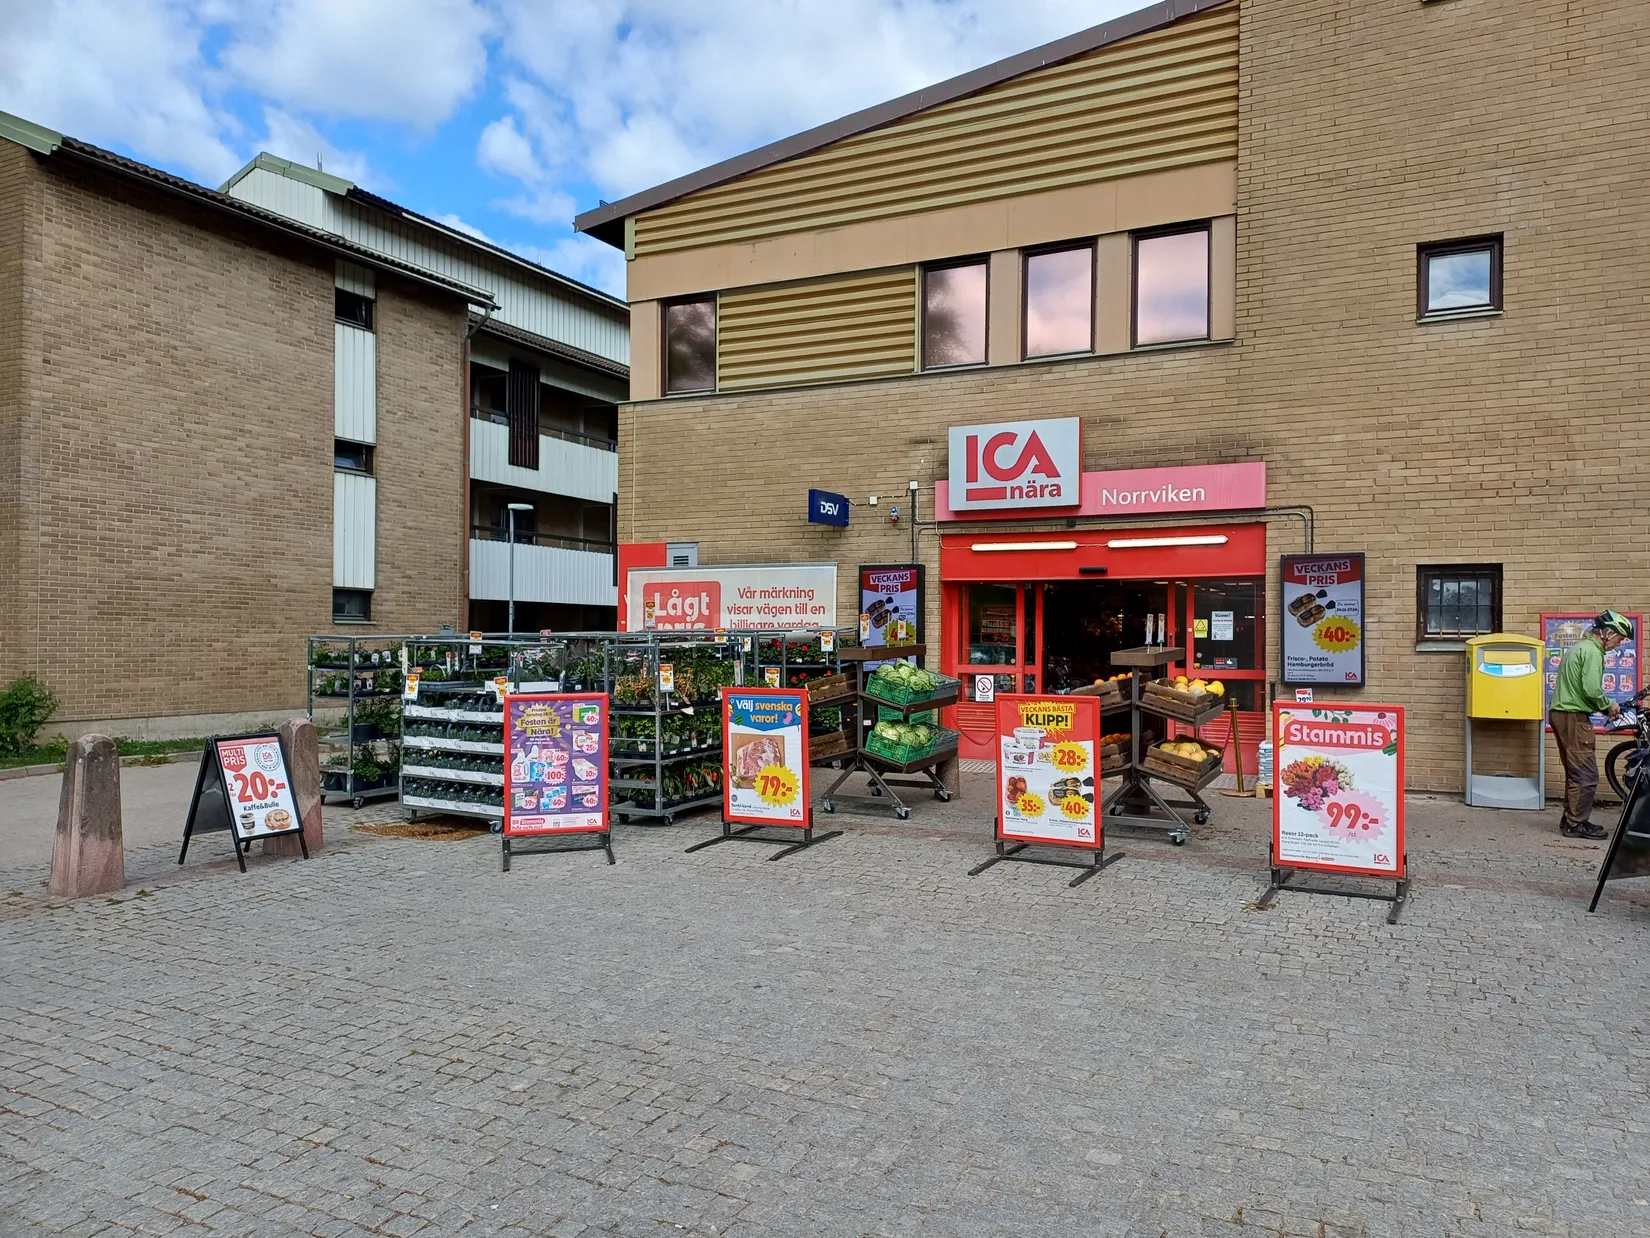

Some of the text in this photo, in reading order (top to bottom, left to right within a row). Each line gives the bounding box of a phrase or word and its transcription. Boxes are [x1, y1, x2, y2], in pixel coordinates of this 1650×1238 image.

[966, 430, 1061, 482] ICA
[1009, 480, 1062, 500] nära
[1102, 483, 1205, 506] Norrviken
[820, 501, 839, 515] DSV
[1296, 561, 1348, 574] VECKANS
[870, 572, 909, 584] VECKANS
[1308, 575, 1335, 585] PRIS
[738, 586, 815, 601] Vår märkning
[880, 584, 899, 593] PRIS
[654, 589, 710, 622] Lågt
[727, 603, 825, 617] visar vägen till en
[1324, 626, 1355, 642] 40:-
[736, 699, 793, 711] Välj svenska
[750, 714, 778, 723] varor!
[1025, 714, 1069, 726] KLIPP!
[1289, 724, 1383, 746] Stammis
[221, 748, 243, 757] MULTI
[1057, 749, 1086, 766] 28:-
[224, 755, 246, 766] PRIS
[228, 783, 234, 791] 2
[233, 771, 286, 803] 20:-
[760, 775, 793, 797] 79:-
[243, 801, 279, 811] Kaffe&Bulle
[1021, 799, 1040, 812] 35:-
[1066, 802, 1089, 815] 40:-
[1327, 802, 1379, 830] 99:-
[1078, 828, 1090, 836] ICA
[1374, 854, 1390, 862] ICA
